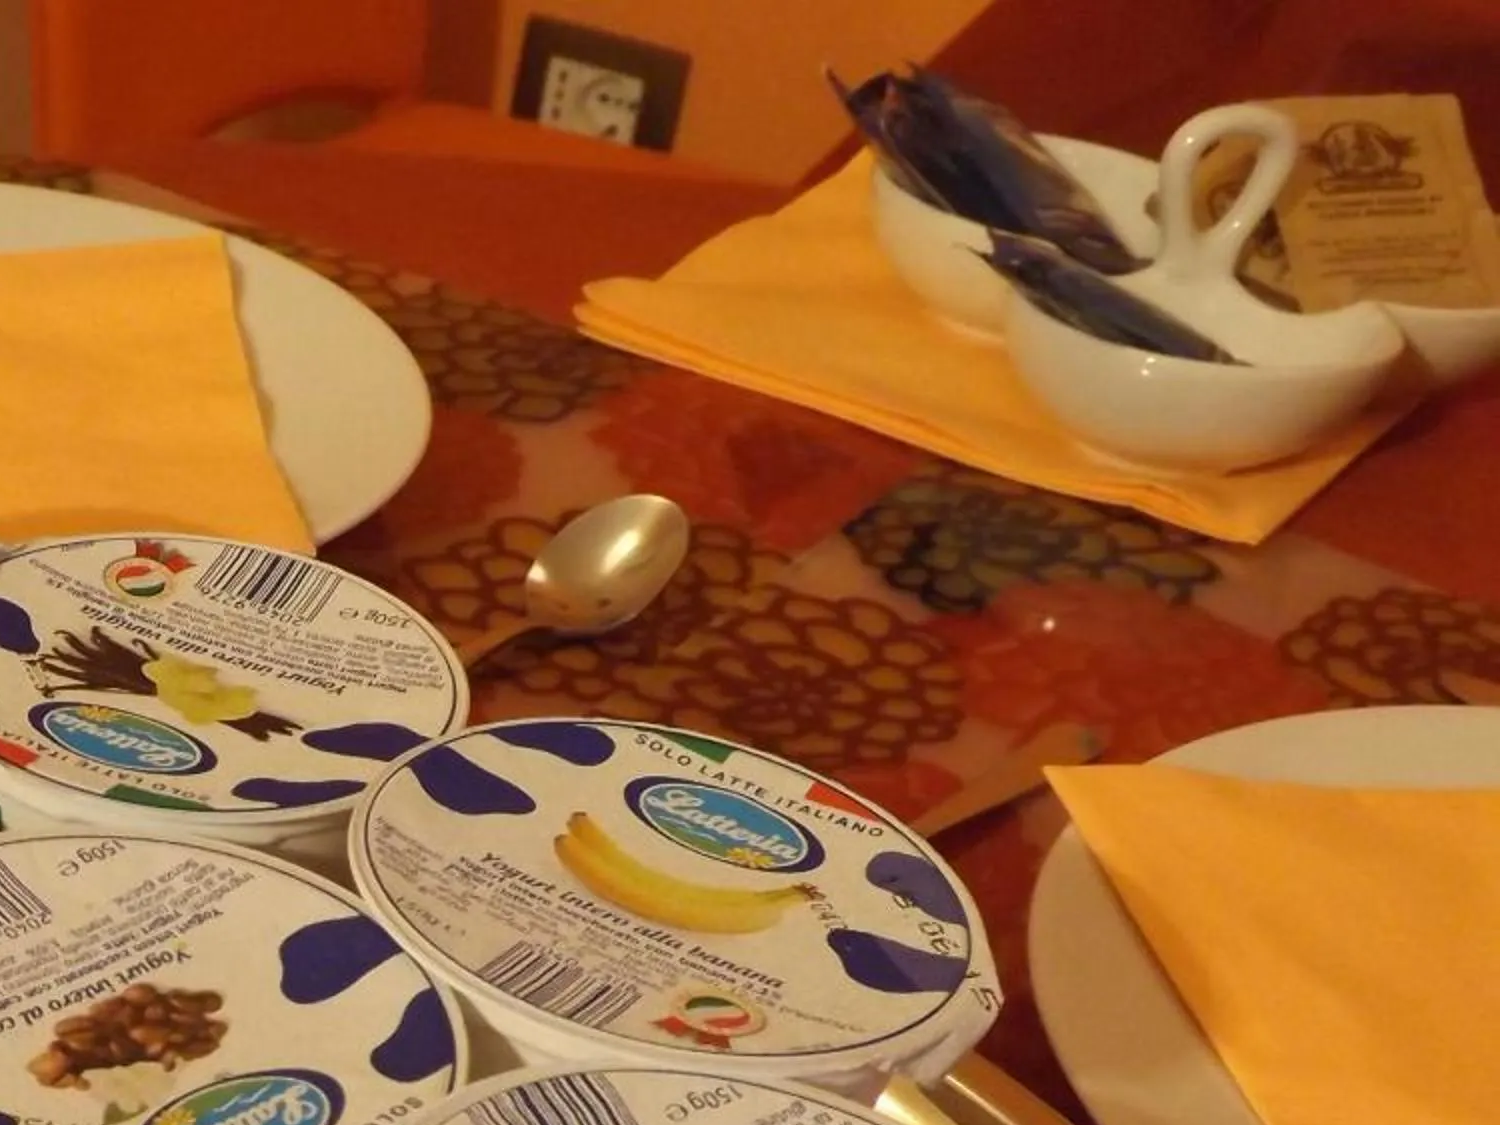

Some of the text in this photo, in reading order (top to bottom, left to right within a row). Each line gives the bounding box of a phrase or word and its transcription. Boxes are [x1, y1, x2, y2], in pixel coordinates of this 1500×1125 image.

[80, 605, 346, 696] Yogurt intero alla vaniglia
[52, 712, 195, 768] Latteria
[634, 732, 886, 838] SOLO LATTE ITALIANO
[648, 790, 800, 860] Latteria
[76, 835, 125, 864] 150g
[481, 852, 783, 999] Yogurt intero alla banana
[115, 949, 191, 984] Yogurt
[19, 1006, 44, 1026] al
[47, 978, 113, 1011] intero
[686, 1077, 743, 1110] 150g
